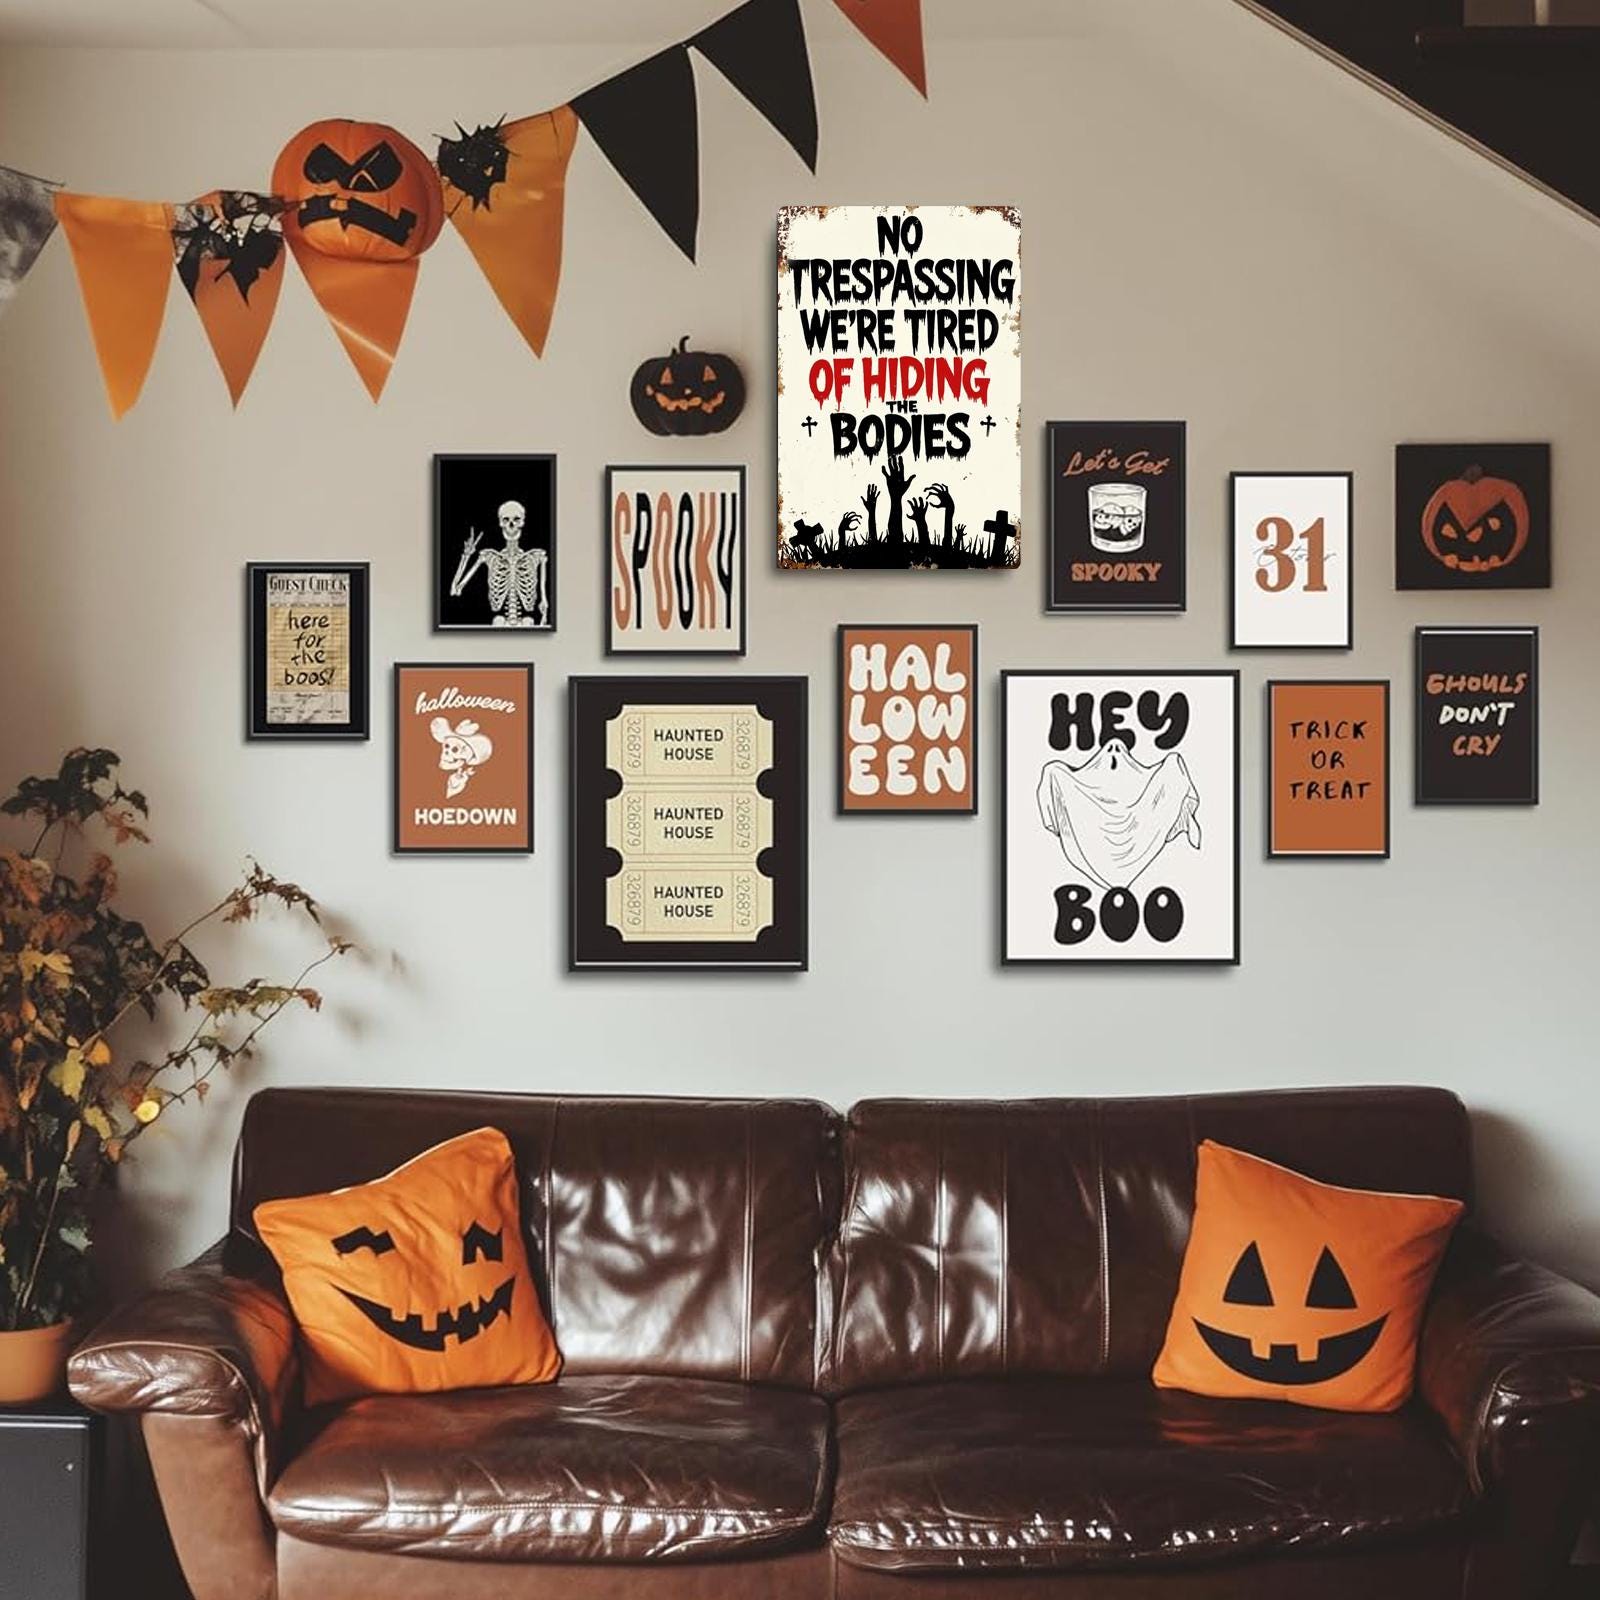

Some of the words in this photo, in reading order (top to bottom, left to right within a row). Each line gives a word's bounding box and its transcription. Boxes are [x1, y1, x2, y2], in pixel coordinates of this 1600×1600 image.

[876, 215, 923, 258] NO
[788, 259, 1016, 309] TRESPASSING
[800, 309, 895, 355] WE'RE
[904, 309, 999, 355] TIRED
[809, 358, 854, 411] OF
[862, 356, 990, 408] HIDING
[886, 400, 918, 413] THE
[830, 413, 971, 465] BODIES
[1062, 449, 1121, 476] Let's
[1125, 451, 1170, 476] Get
[614, 491, 737, 630] SPOOKY
[1255, 517, 1327, 592] 31
[1071, 563, 1162, 582] SPOOKY
[288, 610, 330, 630] here
[294, 632, 326, 649] for
[291, 650, 325, 666] the
[849, 643, 966, 692] HAL
[284, 667, 335, 686] boos!
[1426, 673, 1527, 694] GHOULS
[415, 687, 516, 715] halloween
[1439, 702, 1515, 726] DON'T
[849, 694, 966, 743] LOW
[1048, 690, 1190, 751] HEY
[1290, 720, 1367, 739] TRICK
[627, 718, 641, 769] 326879
[654, 729, 723, 742] HAUNTED
[736, 719, 750, 770] 326879
[1453, 734, 1501, 756] CRY
[664, 748, 714, 761] HOUSE
[1312, 750, 1345, 769] OR
[849, 744, 966, 796] EEN
[1290, 781, 1371, 799] TREAT
[414, 808, 516, 825] HOEDOWN
[627, 796, 641, 848] 326879
[654, 808, 723, 820] HAUNTED
[736, 798, 750, 848] 326879
[664, 826, 714, 840] HOUSE
[627, 875, 641, 926] 326879
[654, 886, 723, 899] HAUNTED
[736, 876, 750, 927] 326879
[664, 905, 714, 918] HOUSE
[1053, 884, 1184, 945] BOO
